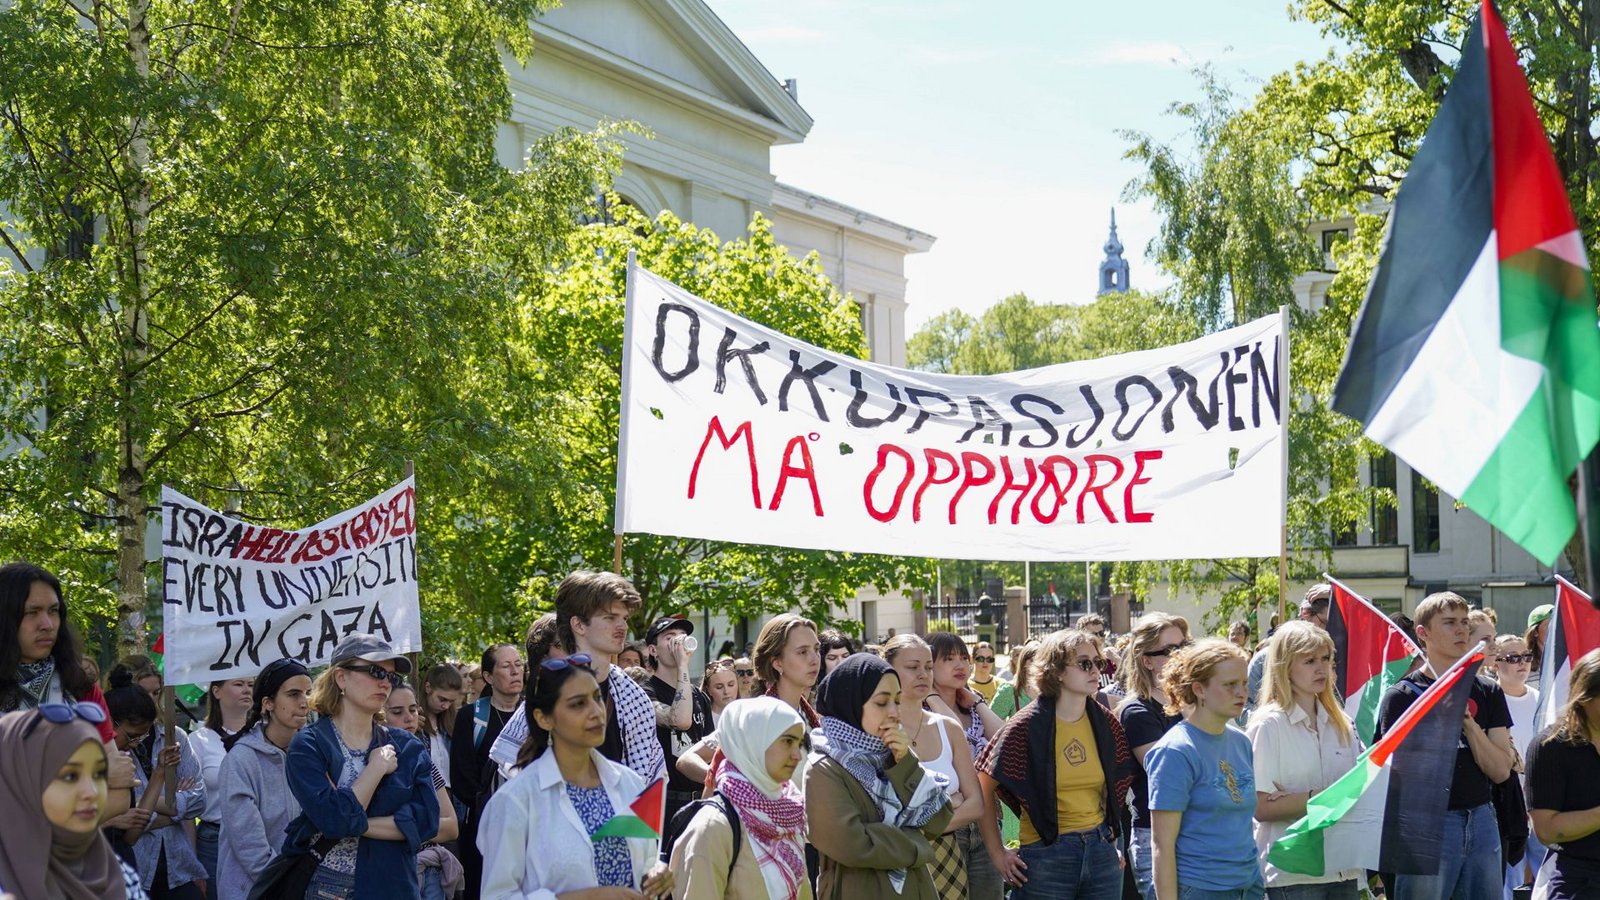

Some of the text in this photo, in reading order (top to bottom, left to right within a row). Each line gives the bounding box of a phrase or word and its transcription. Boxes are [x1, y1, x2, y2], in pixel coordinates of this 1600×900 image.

[653, 302, 1281, 448] OKKUPASJONEN
[688, 416, 1163, 525] MÅ OPPHØRE
[163, 557, 245, 616] EVERY
[209, 601, 392, 671] IN GAZA
